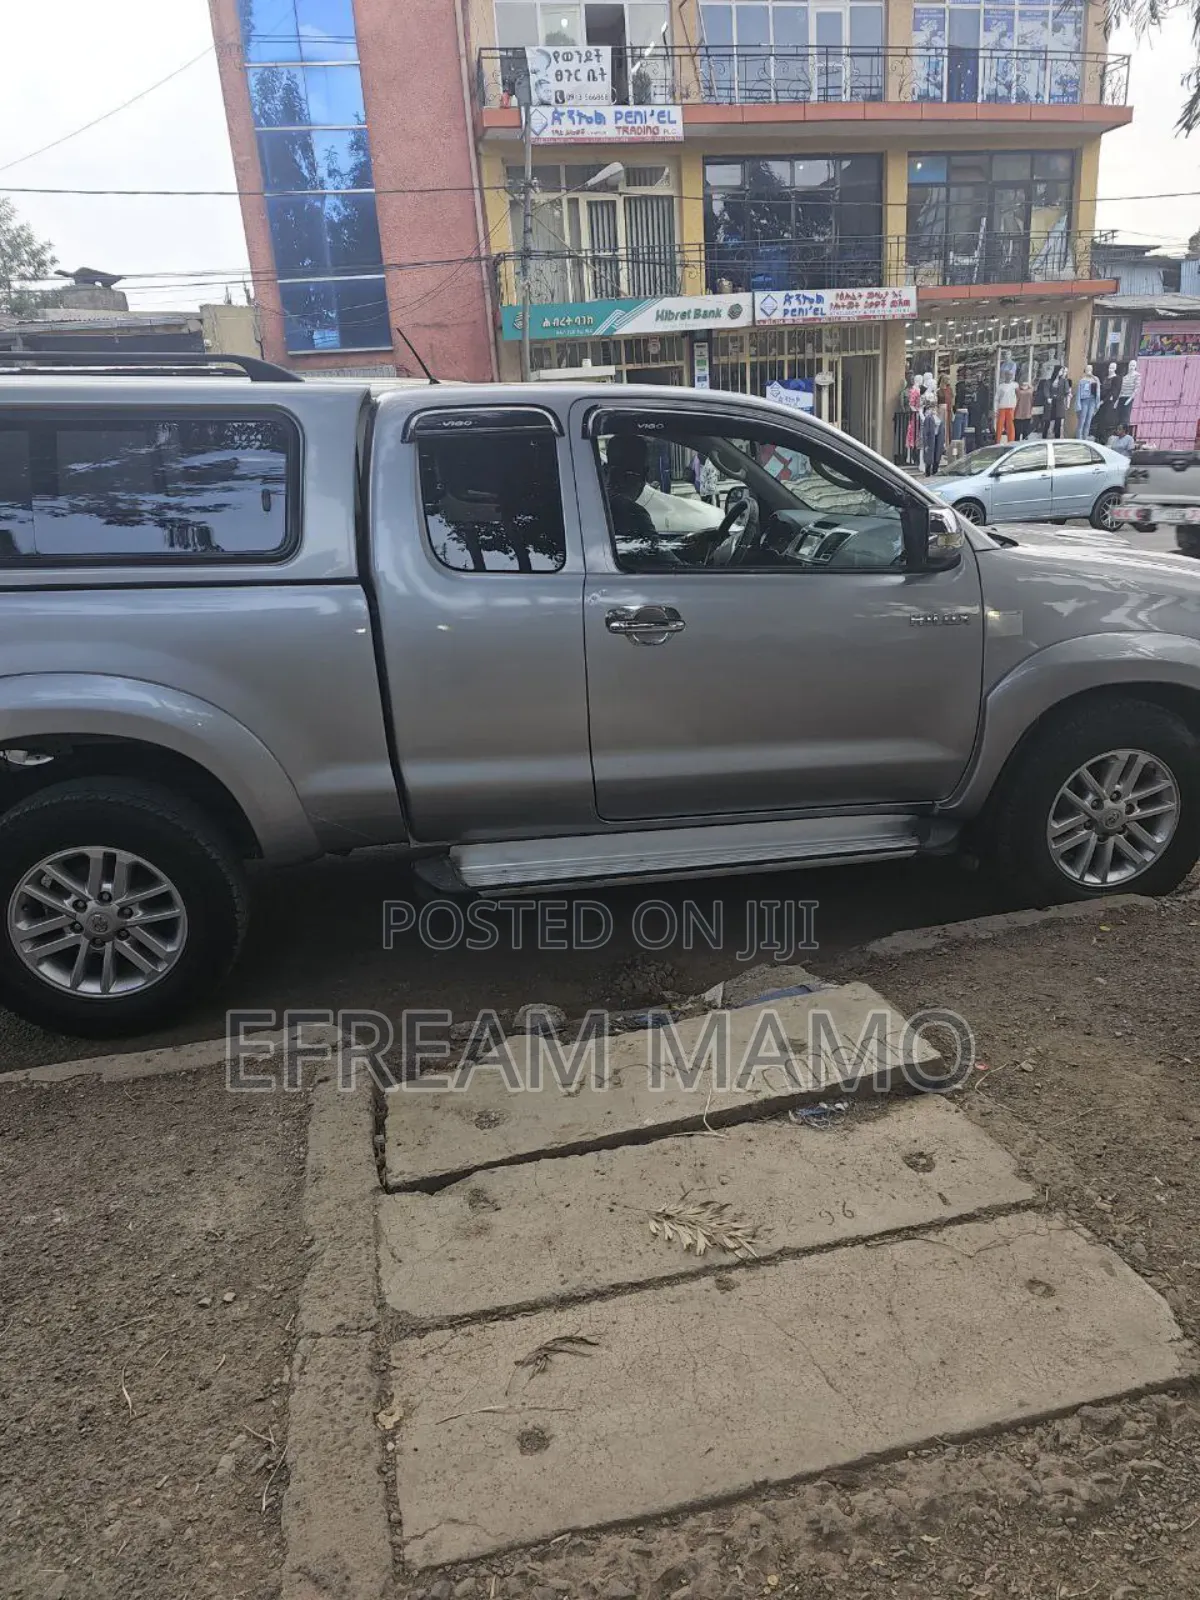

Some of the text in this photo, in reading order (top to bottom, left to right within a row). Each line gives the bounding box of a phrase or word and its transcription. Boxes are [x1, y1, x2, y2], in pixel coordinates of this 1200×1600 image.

[587, 67, 607, 82] ቤት
[615, 125, 660, 136] TRADING
[654, 307, 722, 322] Hibret Bank
